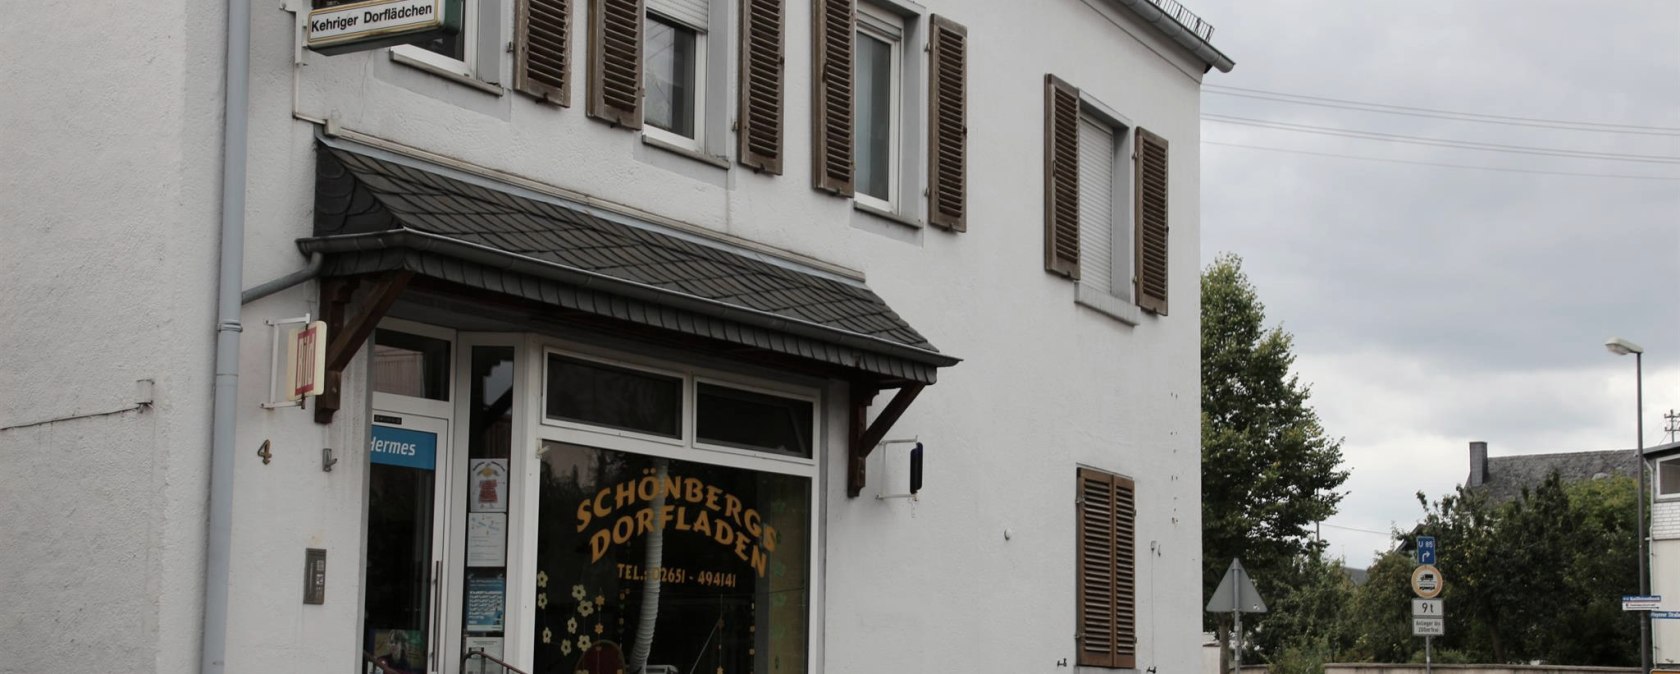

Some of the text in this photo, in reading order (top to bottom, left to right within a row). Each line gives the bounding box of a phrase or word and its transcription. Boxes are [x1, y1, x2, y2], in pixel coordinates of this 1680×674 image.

[311, 4, 433, 33] Kehriger Dorflädchen
[257, 438, 272, 465] 4
[576, 467, 777, 552] SCHÖNBERGS
[588, 504, 768, 578] DORFLADEN
[697, 570, 736, 588] 494141
[1421, 602, 1434, 613] 9 t
